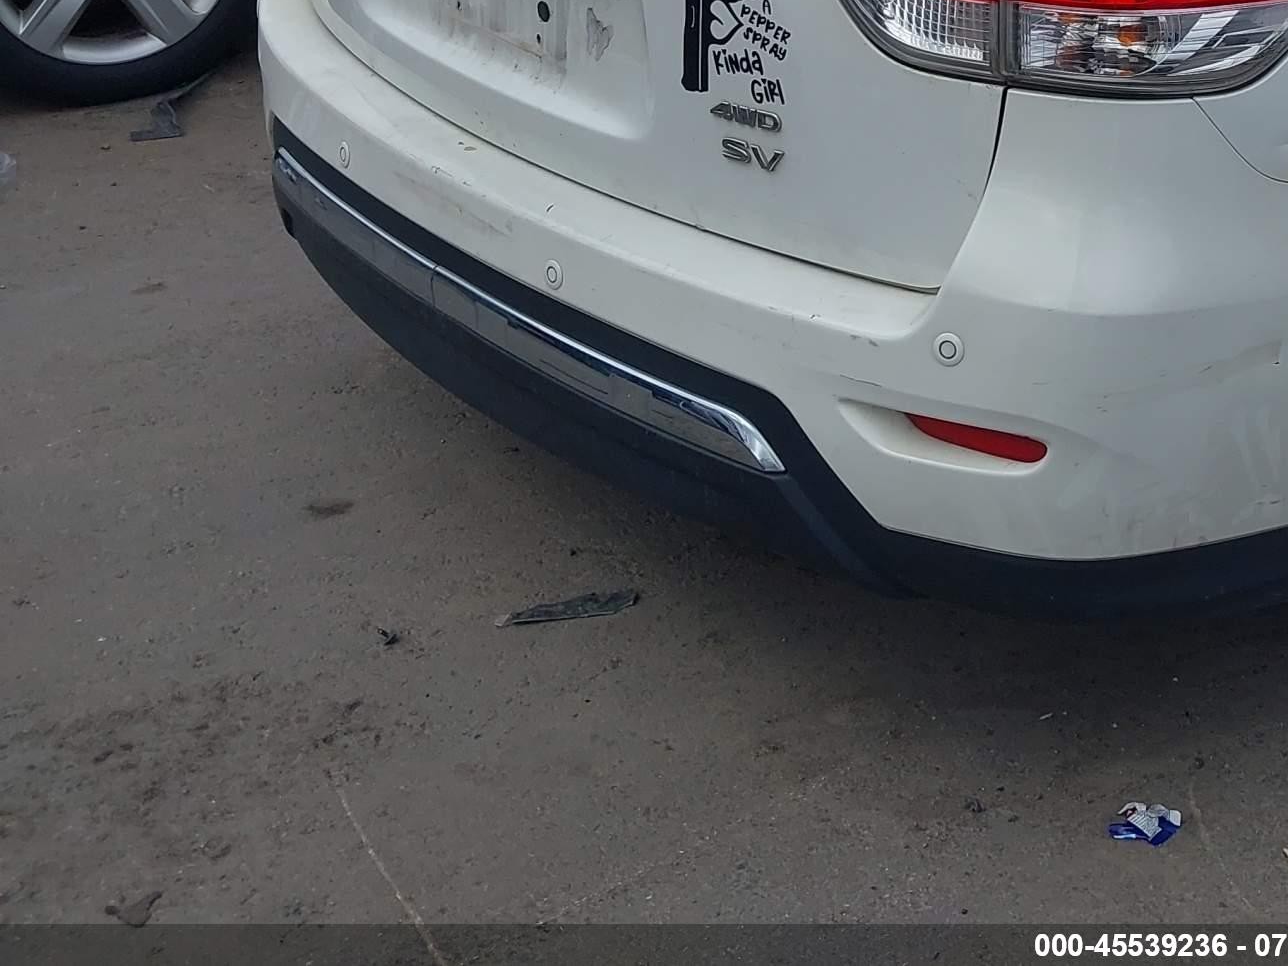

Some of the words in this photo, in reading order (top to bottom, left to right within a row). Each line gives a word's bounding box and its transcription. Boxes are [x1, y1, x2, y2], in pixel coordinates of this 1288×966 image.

[740, 4, 792, 44] PEPPER
[762, 0, 772, 14] A
[743, 26, 787, 61] SPRAY
[710, 101, 783, 133] 4WD
[722, 137, 785, 172] SV
